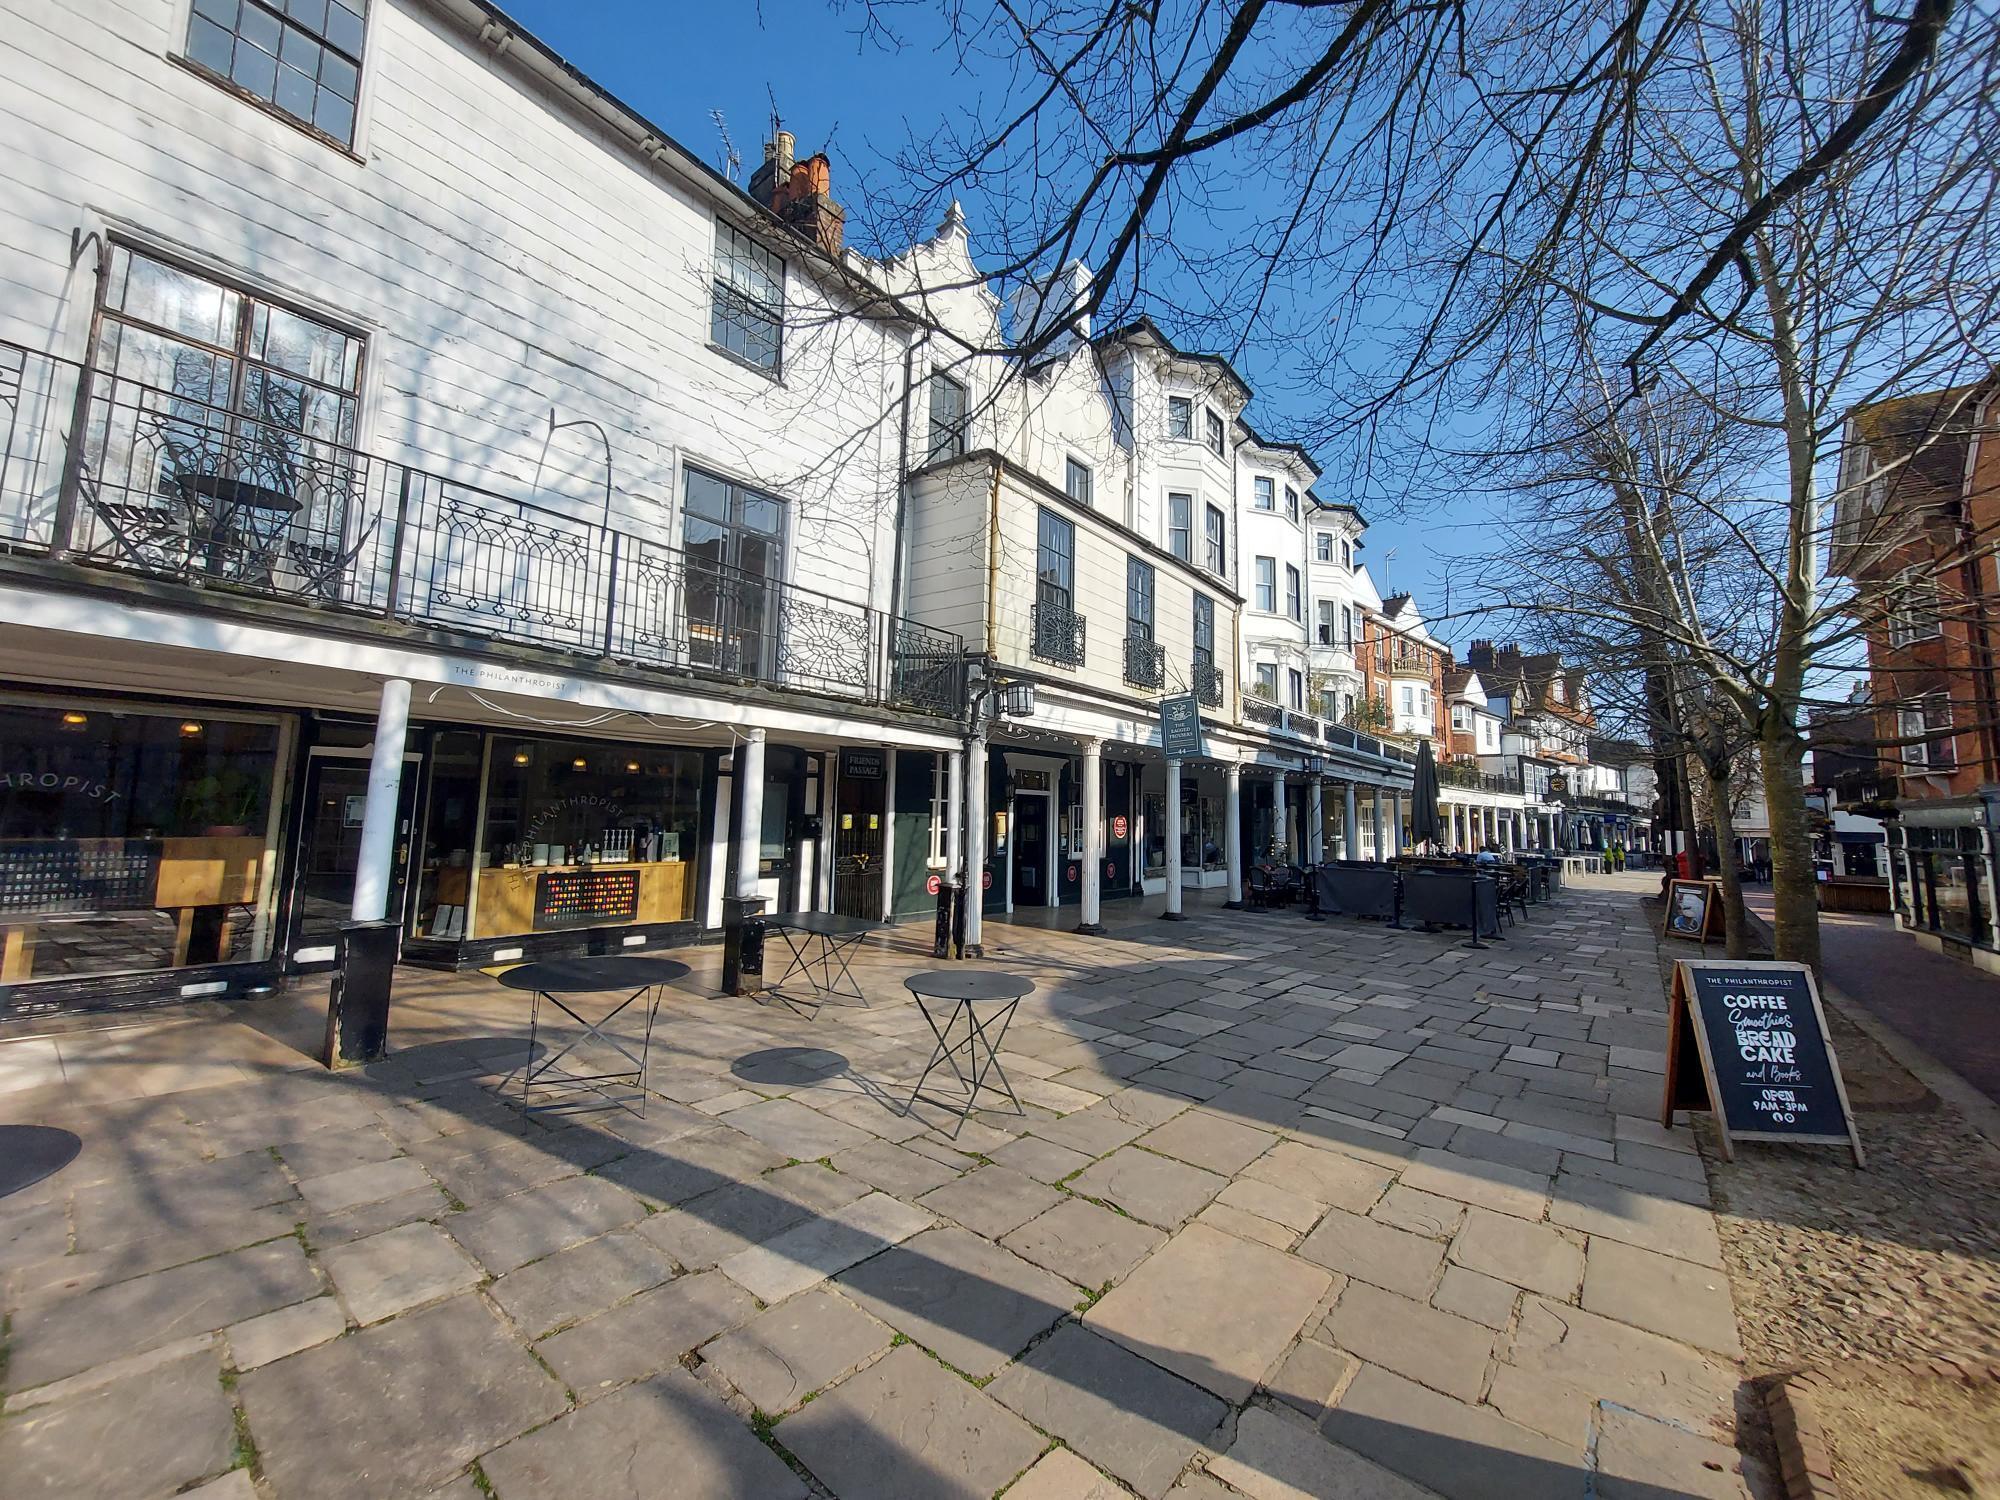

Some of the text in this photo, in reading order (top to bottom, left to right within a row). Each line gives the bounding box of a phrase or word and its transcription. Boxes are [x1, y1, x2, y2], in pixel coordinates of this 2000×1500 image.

[455, 666, 566, 691] THE PHILANTHROPIST
[849, 756, 880, 765] FRIENDS
[849, 766, 879, 775] PASSAGE
[521, 795, 624, 849] PHILANTHROPIST
[16, 872, 60, 880] BREAD
[41, 892, 93, 901] SUNDAY
[1706, 977, 1793, 986] THE PHILANTHROPIST
[1723, 994, 1788, 1010] COFFEE
[1728, 1008, 1793, 1032] Smoothies
[1735, 1029, 1797, 1048] BREAD
[1740, 1045, 1796, 1064] CAKE
[1745, 1063, 1802, 1083] and Books
[1761, 1089, 1796, 1102] OPEN
